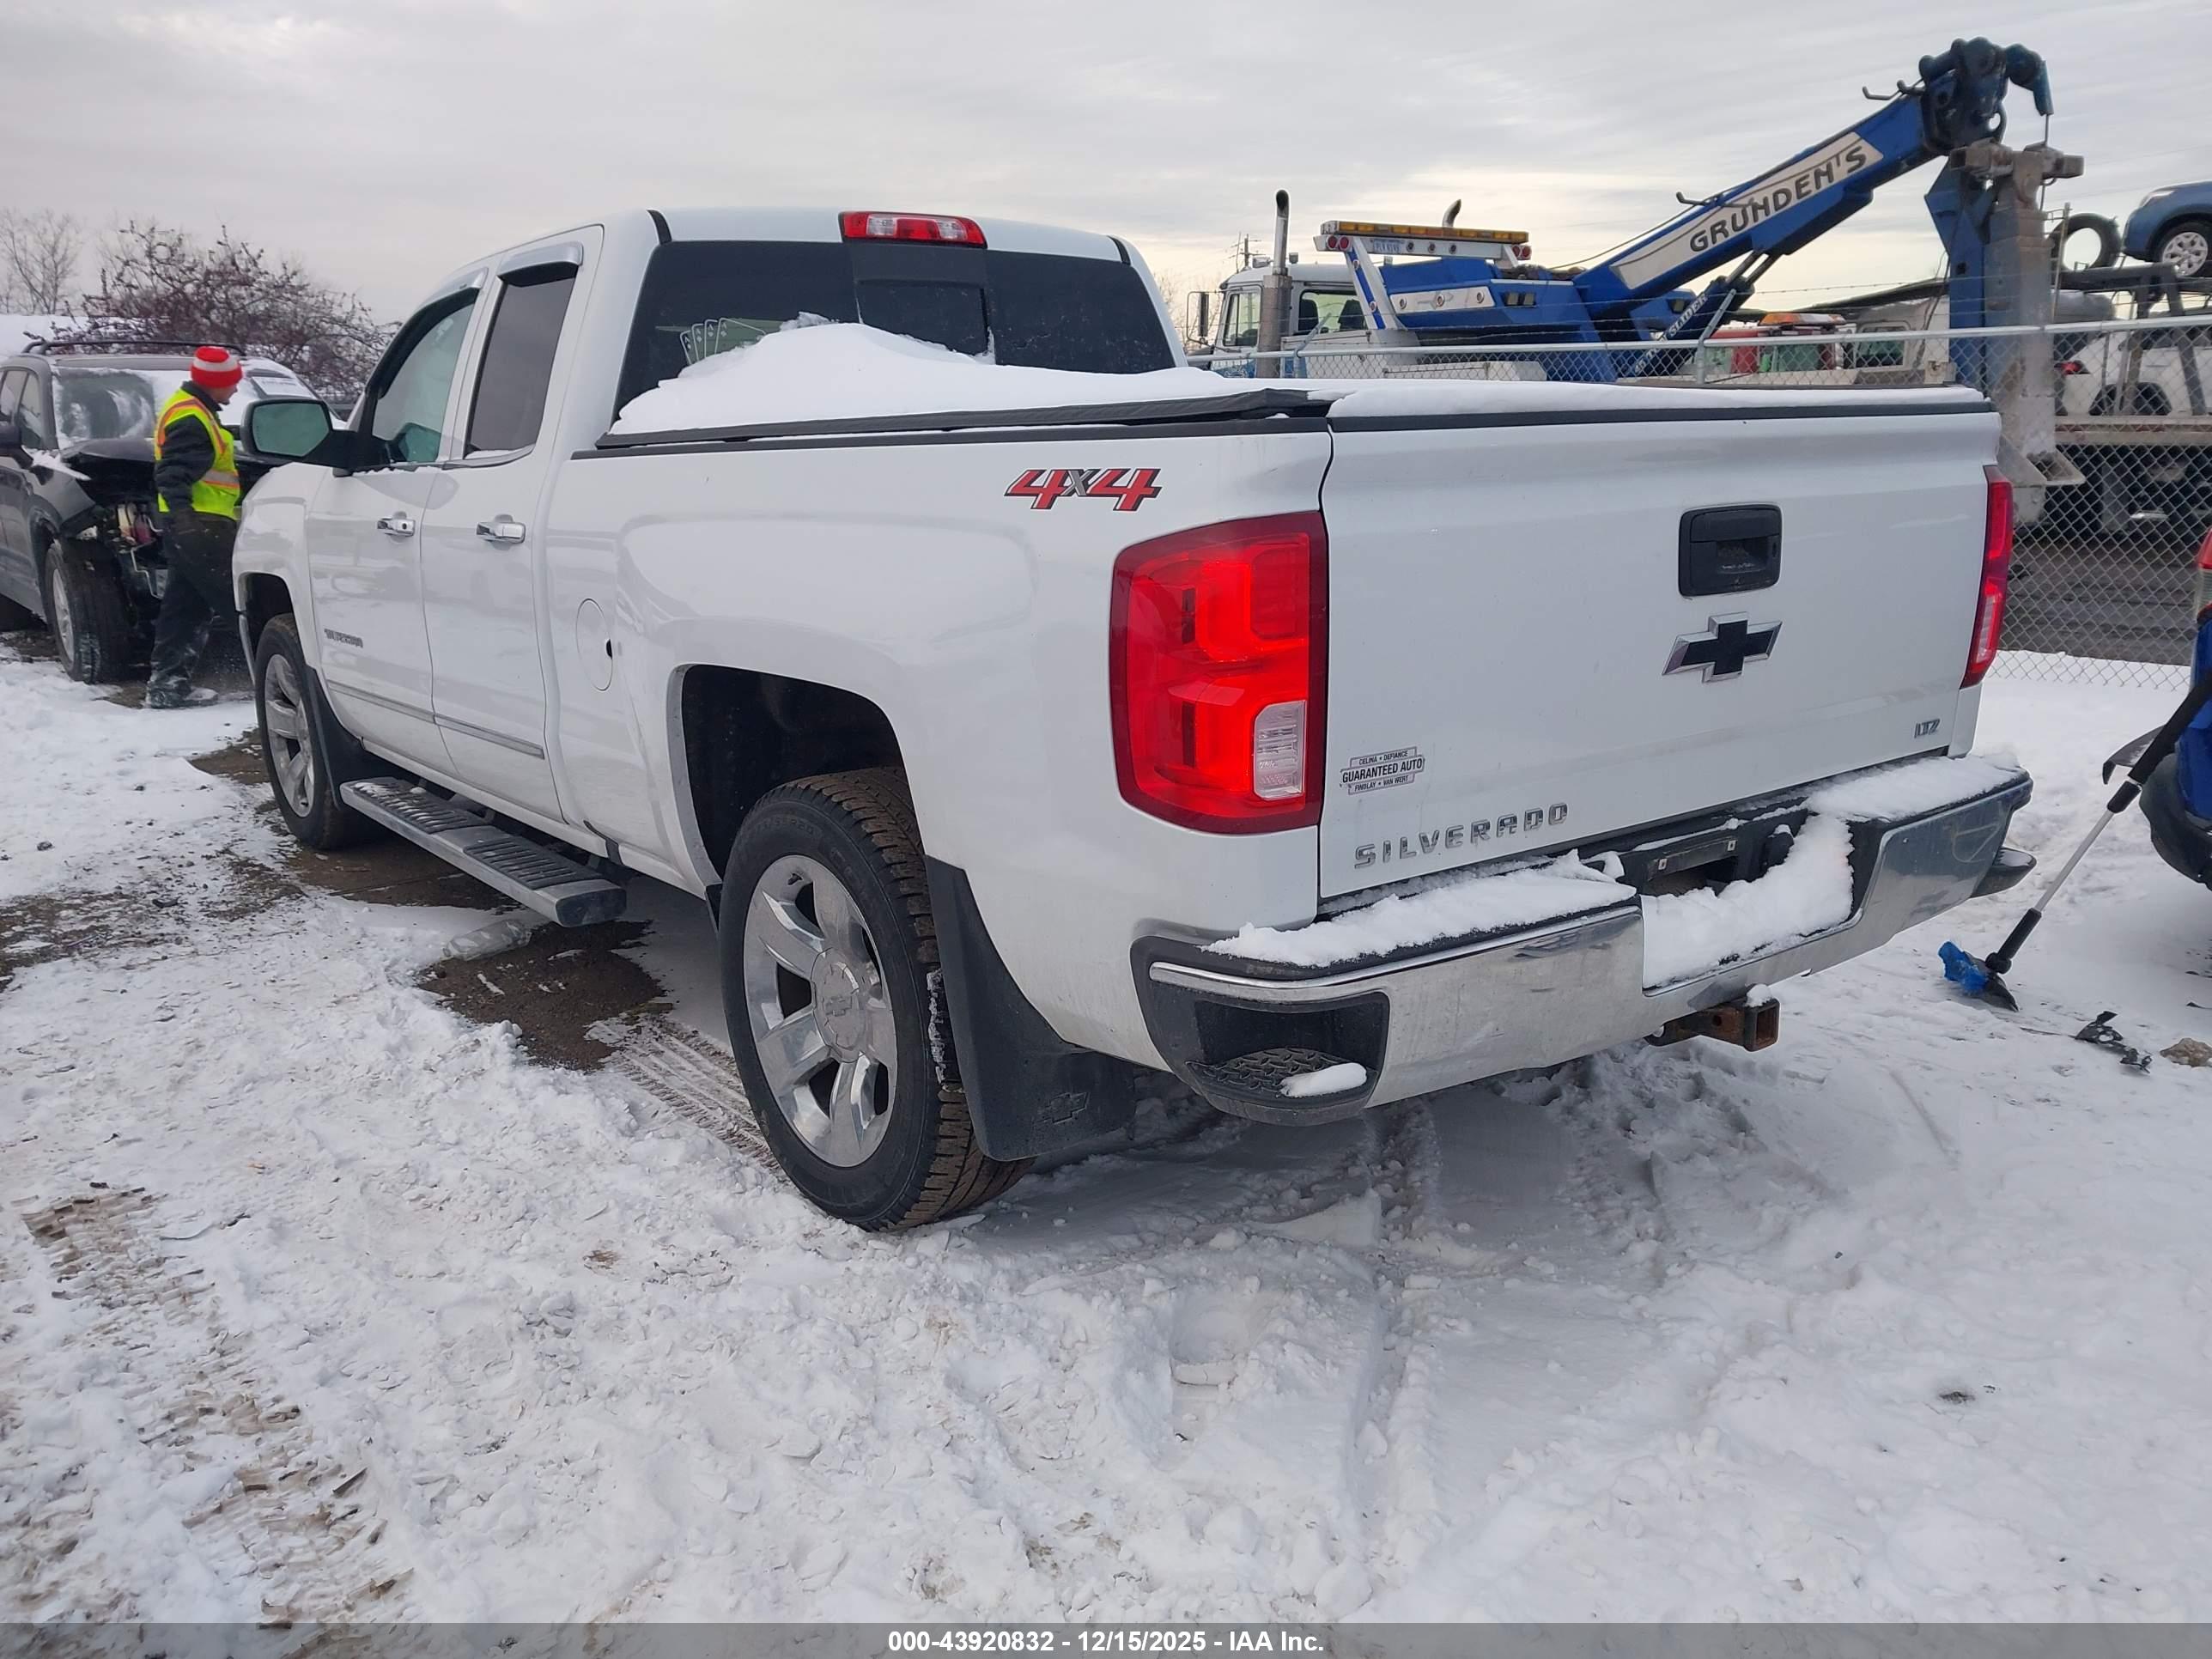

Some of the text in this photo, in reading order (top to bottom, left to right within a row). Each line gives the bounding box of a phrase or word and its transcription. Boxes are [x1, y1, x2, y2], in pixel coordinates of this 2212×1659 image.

[1689, 145, 1867, 252] GRUNDEN'S
[1668, 293, 1708, 337] SLIDER
[1342, 757, 1422, 783] GUARANTEED AUTO
[1358, 750, 1408, 765] CELINA DEFIANCE
[1354, 781, 1376, 791] FINDLAY
[1395, 775, 1409, 784] WERT
[1353, 802, 1569, 869] SILVERADO
